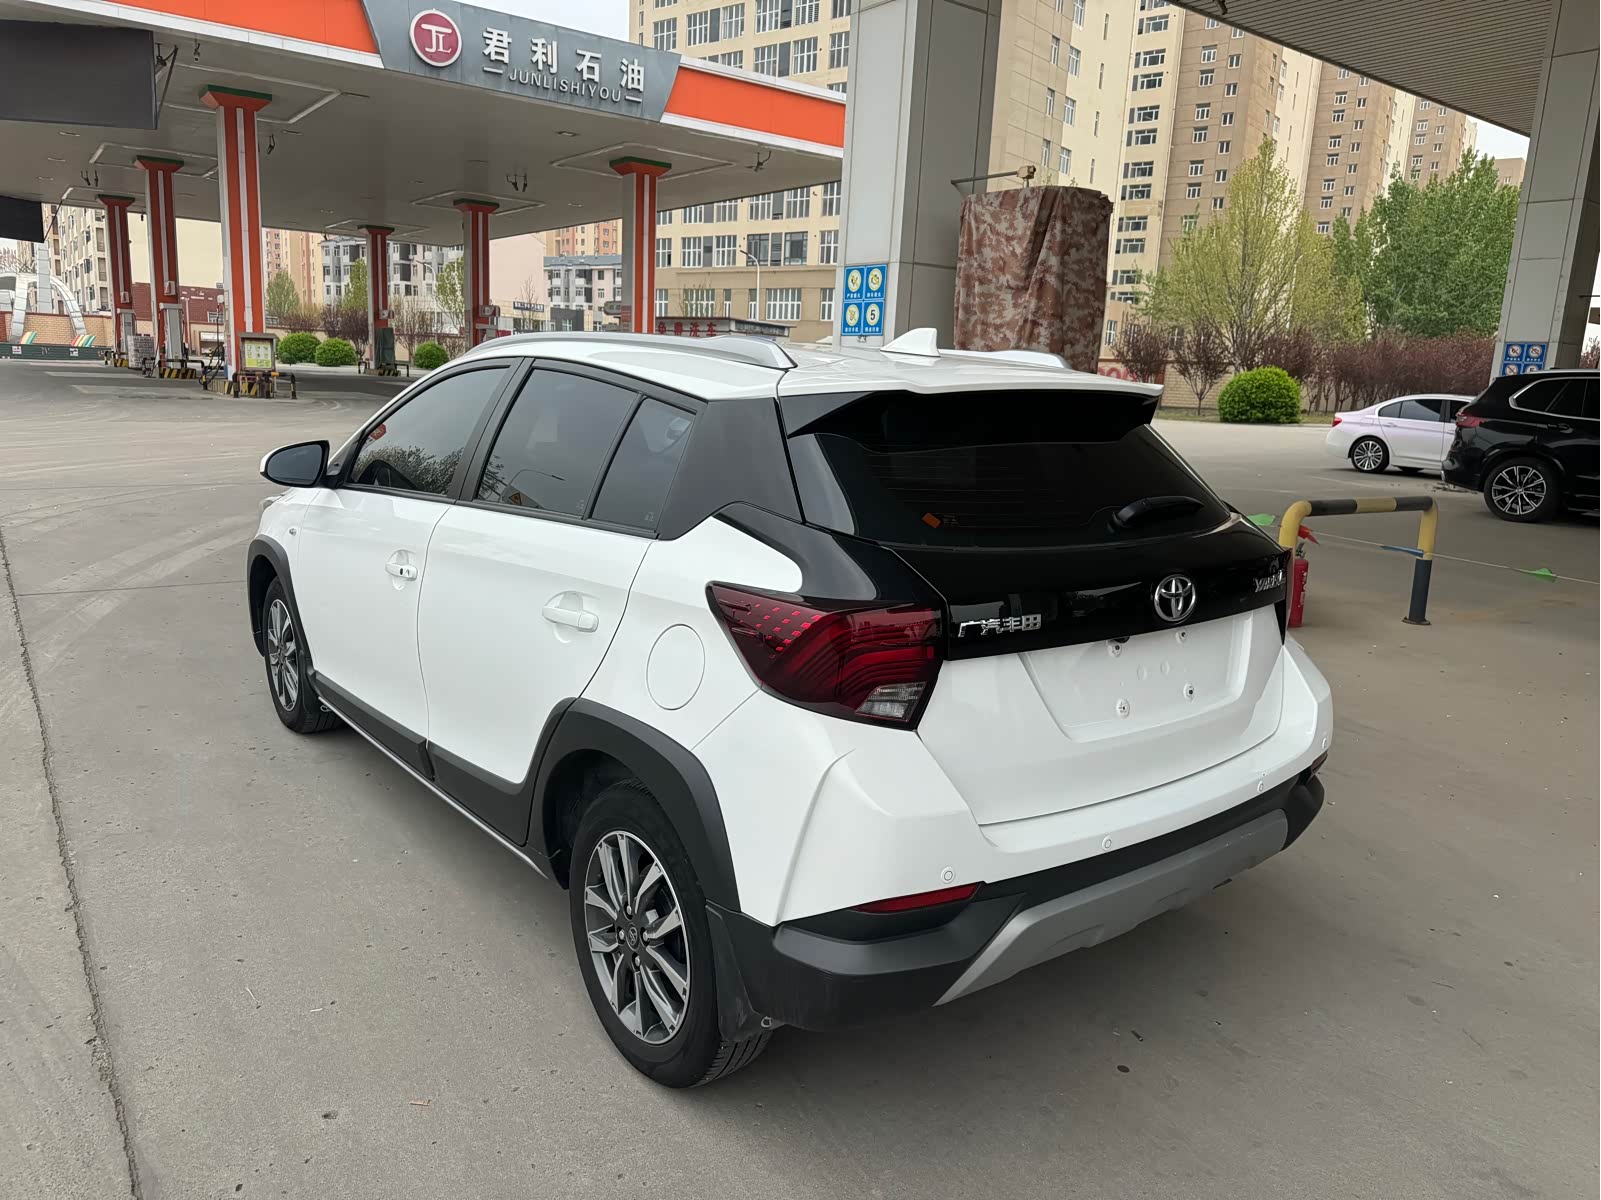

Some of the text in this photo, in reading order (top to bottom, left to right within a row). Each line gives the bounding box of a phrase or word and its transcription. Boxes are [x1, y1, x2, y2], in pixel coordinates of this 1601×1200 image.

[482, 27, 645, 92] 君利石油
[508, 68, 622, 102] JUNLISHIYOU
[870, 309, 876, 321] 5
[957, 613, 1042, 638] 广汽丰田
